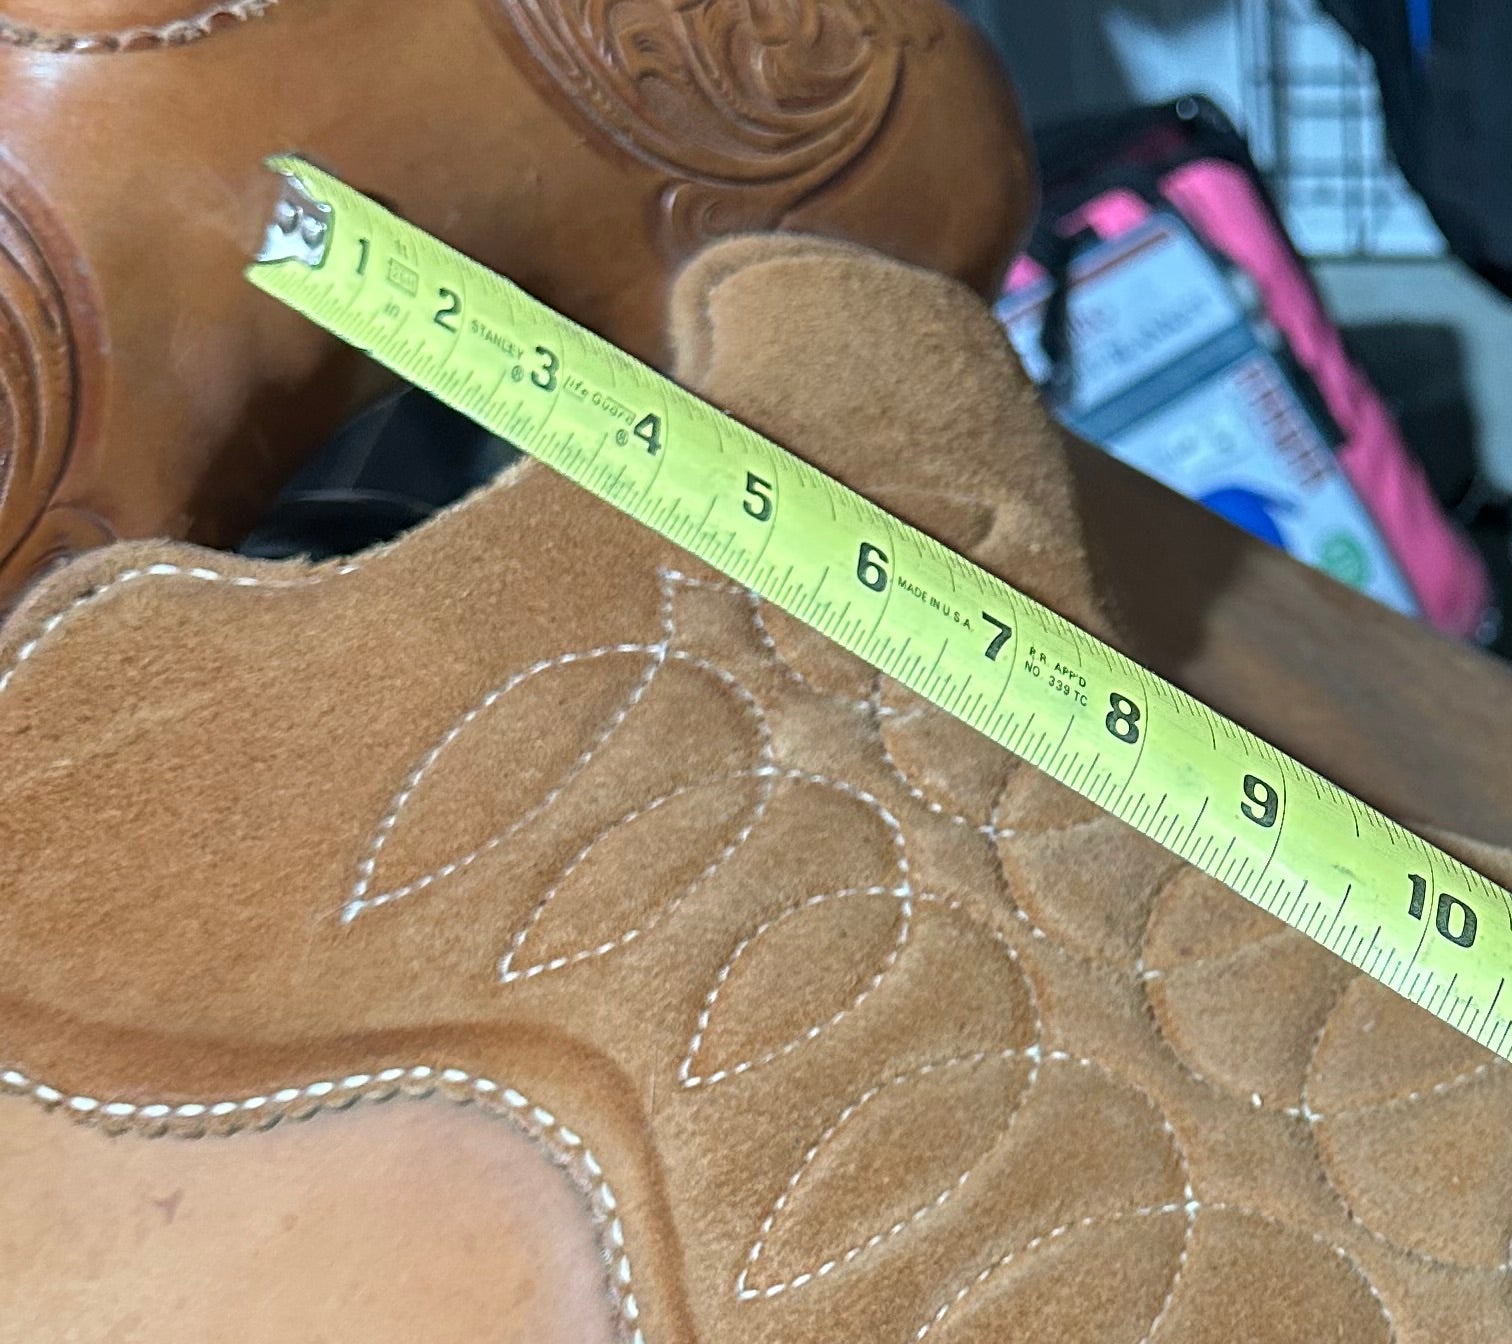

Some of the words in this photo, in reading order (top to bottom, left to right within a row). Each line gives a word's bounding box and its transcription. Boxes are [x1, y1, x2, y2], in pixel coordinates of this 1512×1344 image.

[358, 238, 371, 275] 1
[433, 287, 462, 334] 2
[471, 319, 524, 360] STANLEY
[531, 345, 560, 393] 3
[633, 413, 662, 456] 4
[742, 471, 774, 523] 5
[857, 542, 889, 592] 6
[898, 576, 927, 603] MADE
[930, 597, 941, 611] IN
[981, 611, 1013, 662] 7
[1048, 675, 1070, 696] 339
[1074, 690, 1088, 706] TC
[1105, 692, 1141, 744] 8
[1240, 774, 1278, 827] 9
[1407, 873, 1478, 948] 10
